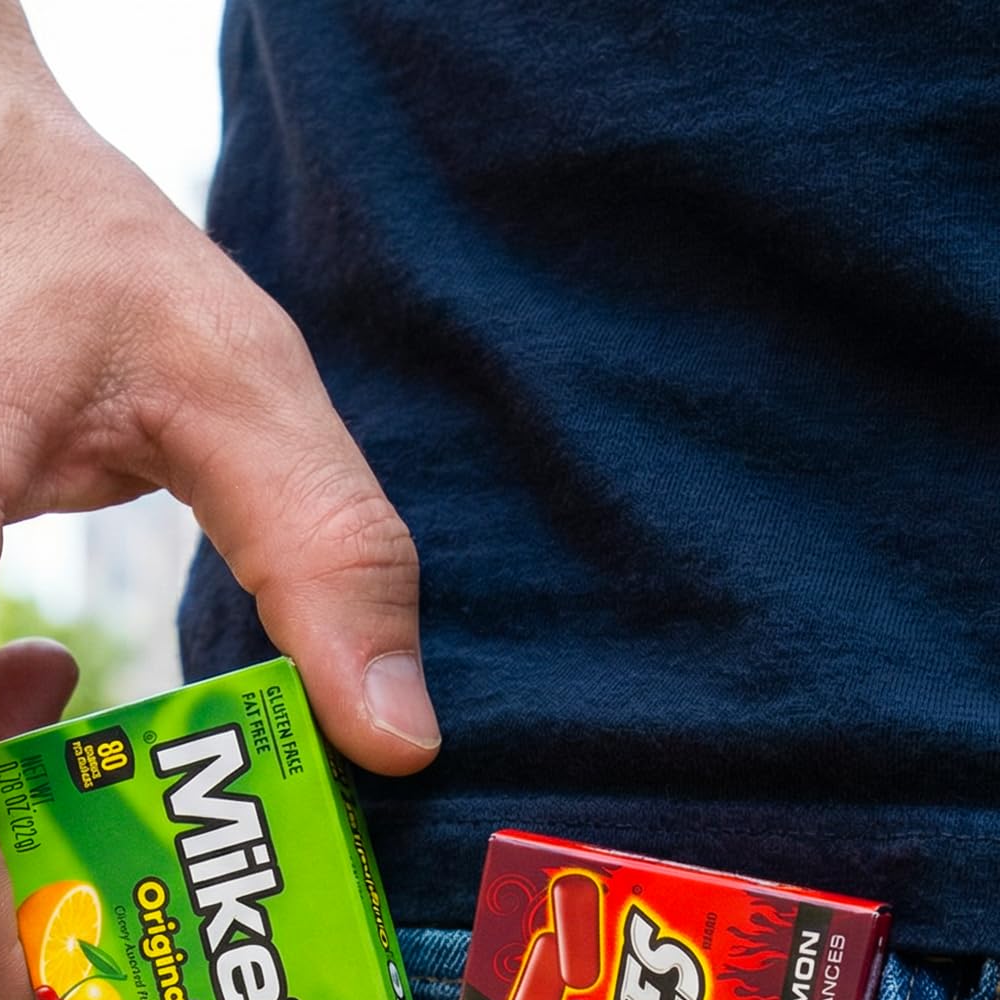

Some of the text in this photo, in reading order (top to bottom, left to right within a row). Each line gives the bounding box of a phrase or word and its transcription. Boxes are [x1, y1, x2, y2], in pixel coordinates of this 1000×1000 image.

[266, 685, 294, 740] GLUTEN
[97, 739, 128, 772] 80
[249, 720, 271, 755] FREE
[8, 815, 42, 854] (22g)
